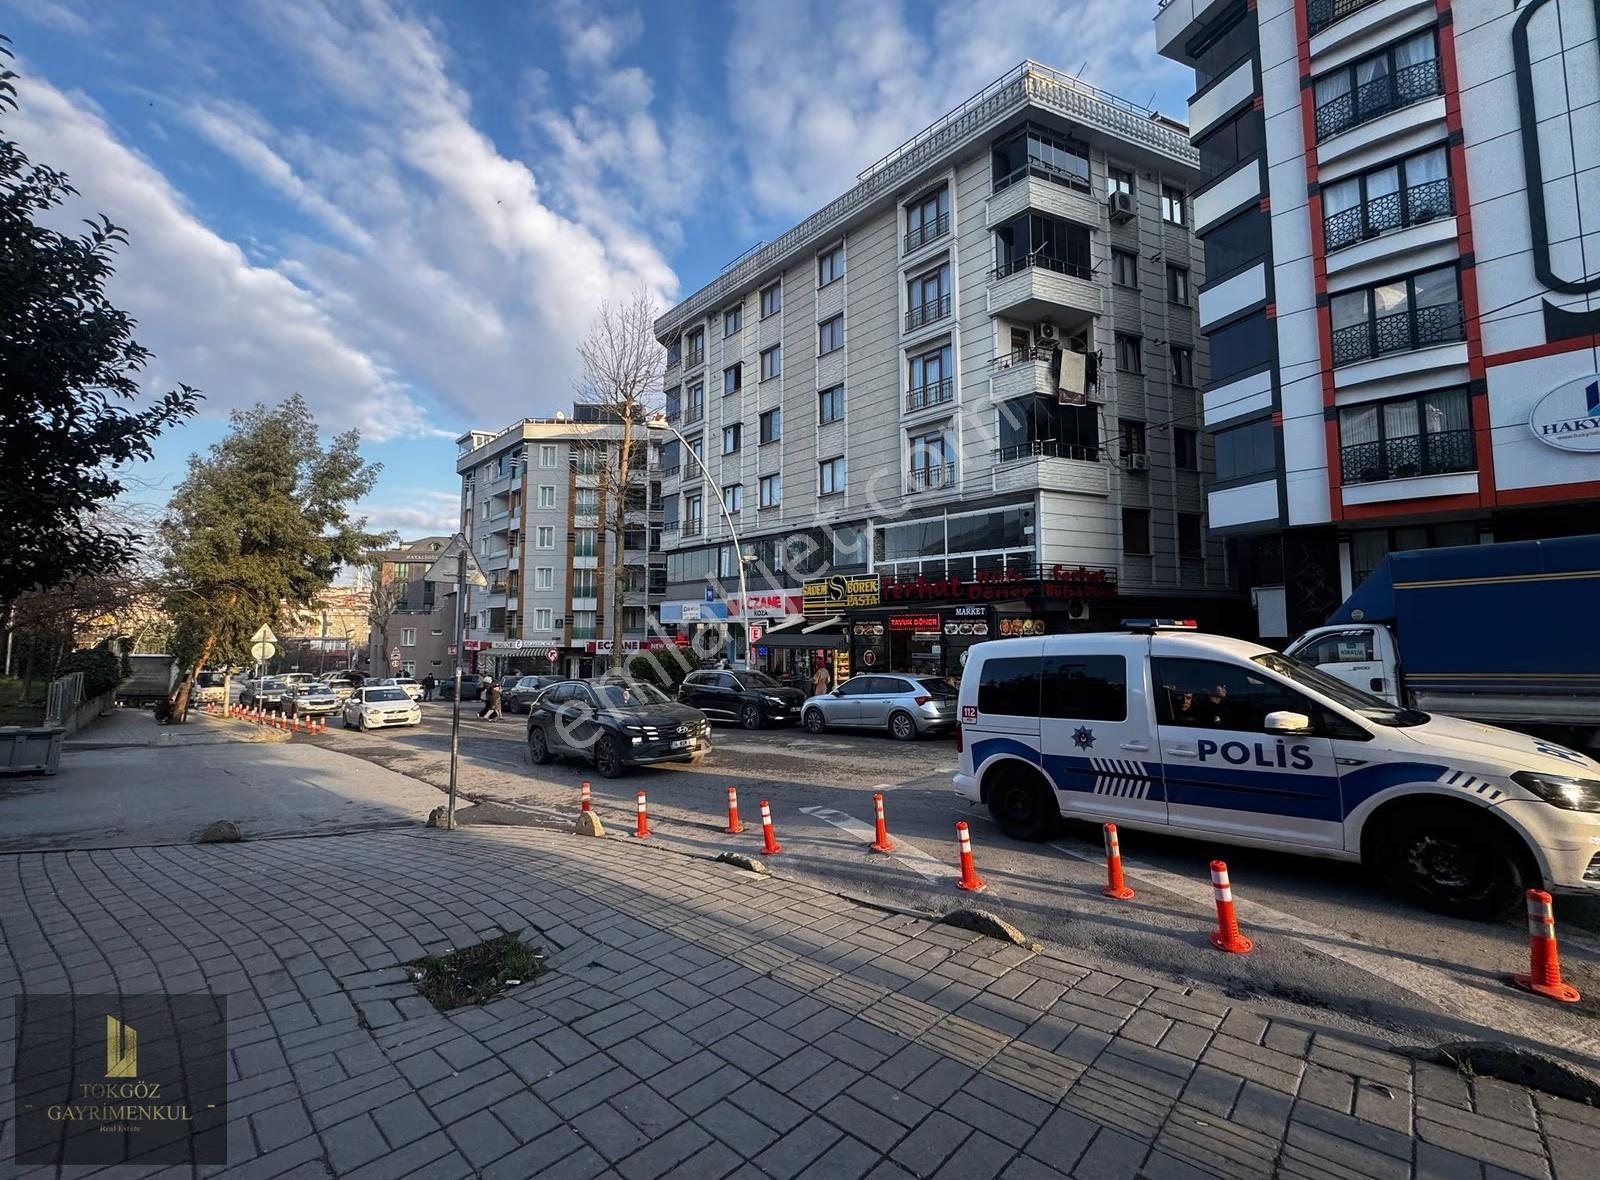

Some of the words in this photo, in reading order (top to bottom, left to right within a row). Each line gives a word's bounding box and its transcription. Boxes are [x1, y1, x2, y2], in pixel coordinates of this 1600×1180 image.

[746, 595, 782, 610] CZANE
[847, 595, 877, 607] PASTA
[955, 607, 985, 616] MARKET
[914, 617, 938, 626] DÖNER
[753, 629, 759, 639] E
[964, 707, 976, 717] 112
[1197, 739, 1314, 770] POLİS
